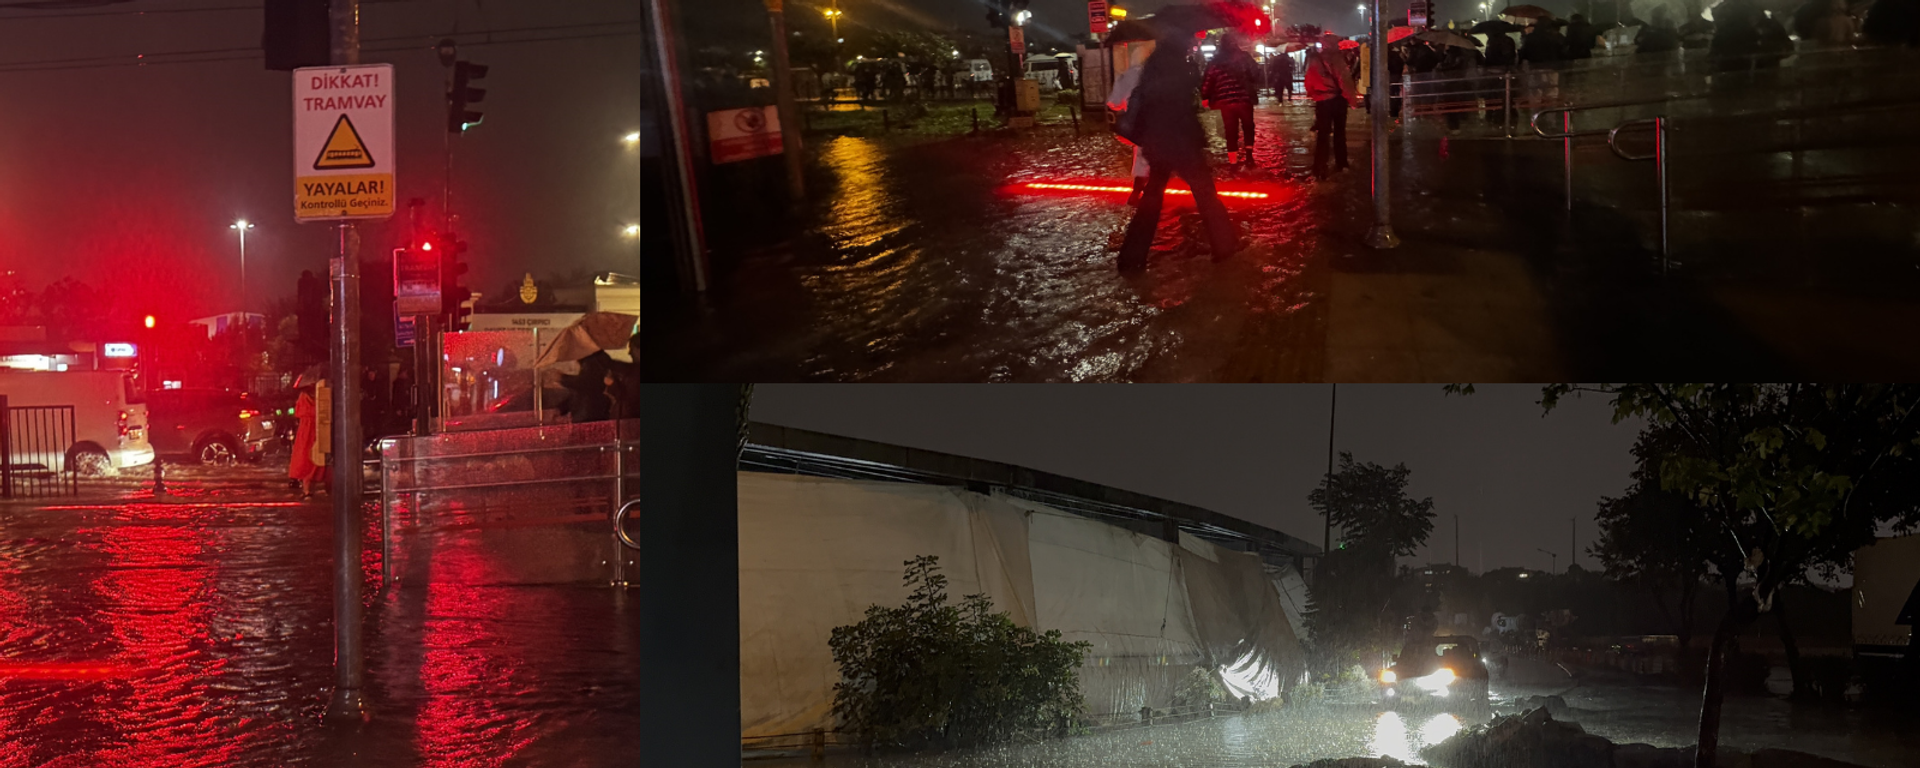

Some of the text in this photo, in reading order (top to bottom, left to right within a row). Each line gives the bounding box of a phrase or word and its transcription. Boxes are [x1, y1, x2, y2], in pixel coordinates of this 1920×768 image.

[311, 73, 379, 90] DİKKAT!
[303, 94, 387, 111] TRAMVAY
[303, 180, 384, 197] YAYALAR!
[300, 197, 389, 210] Kontrollü Geçiniz.
